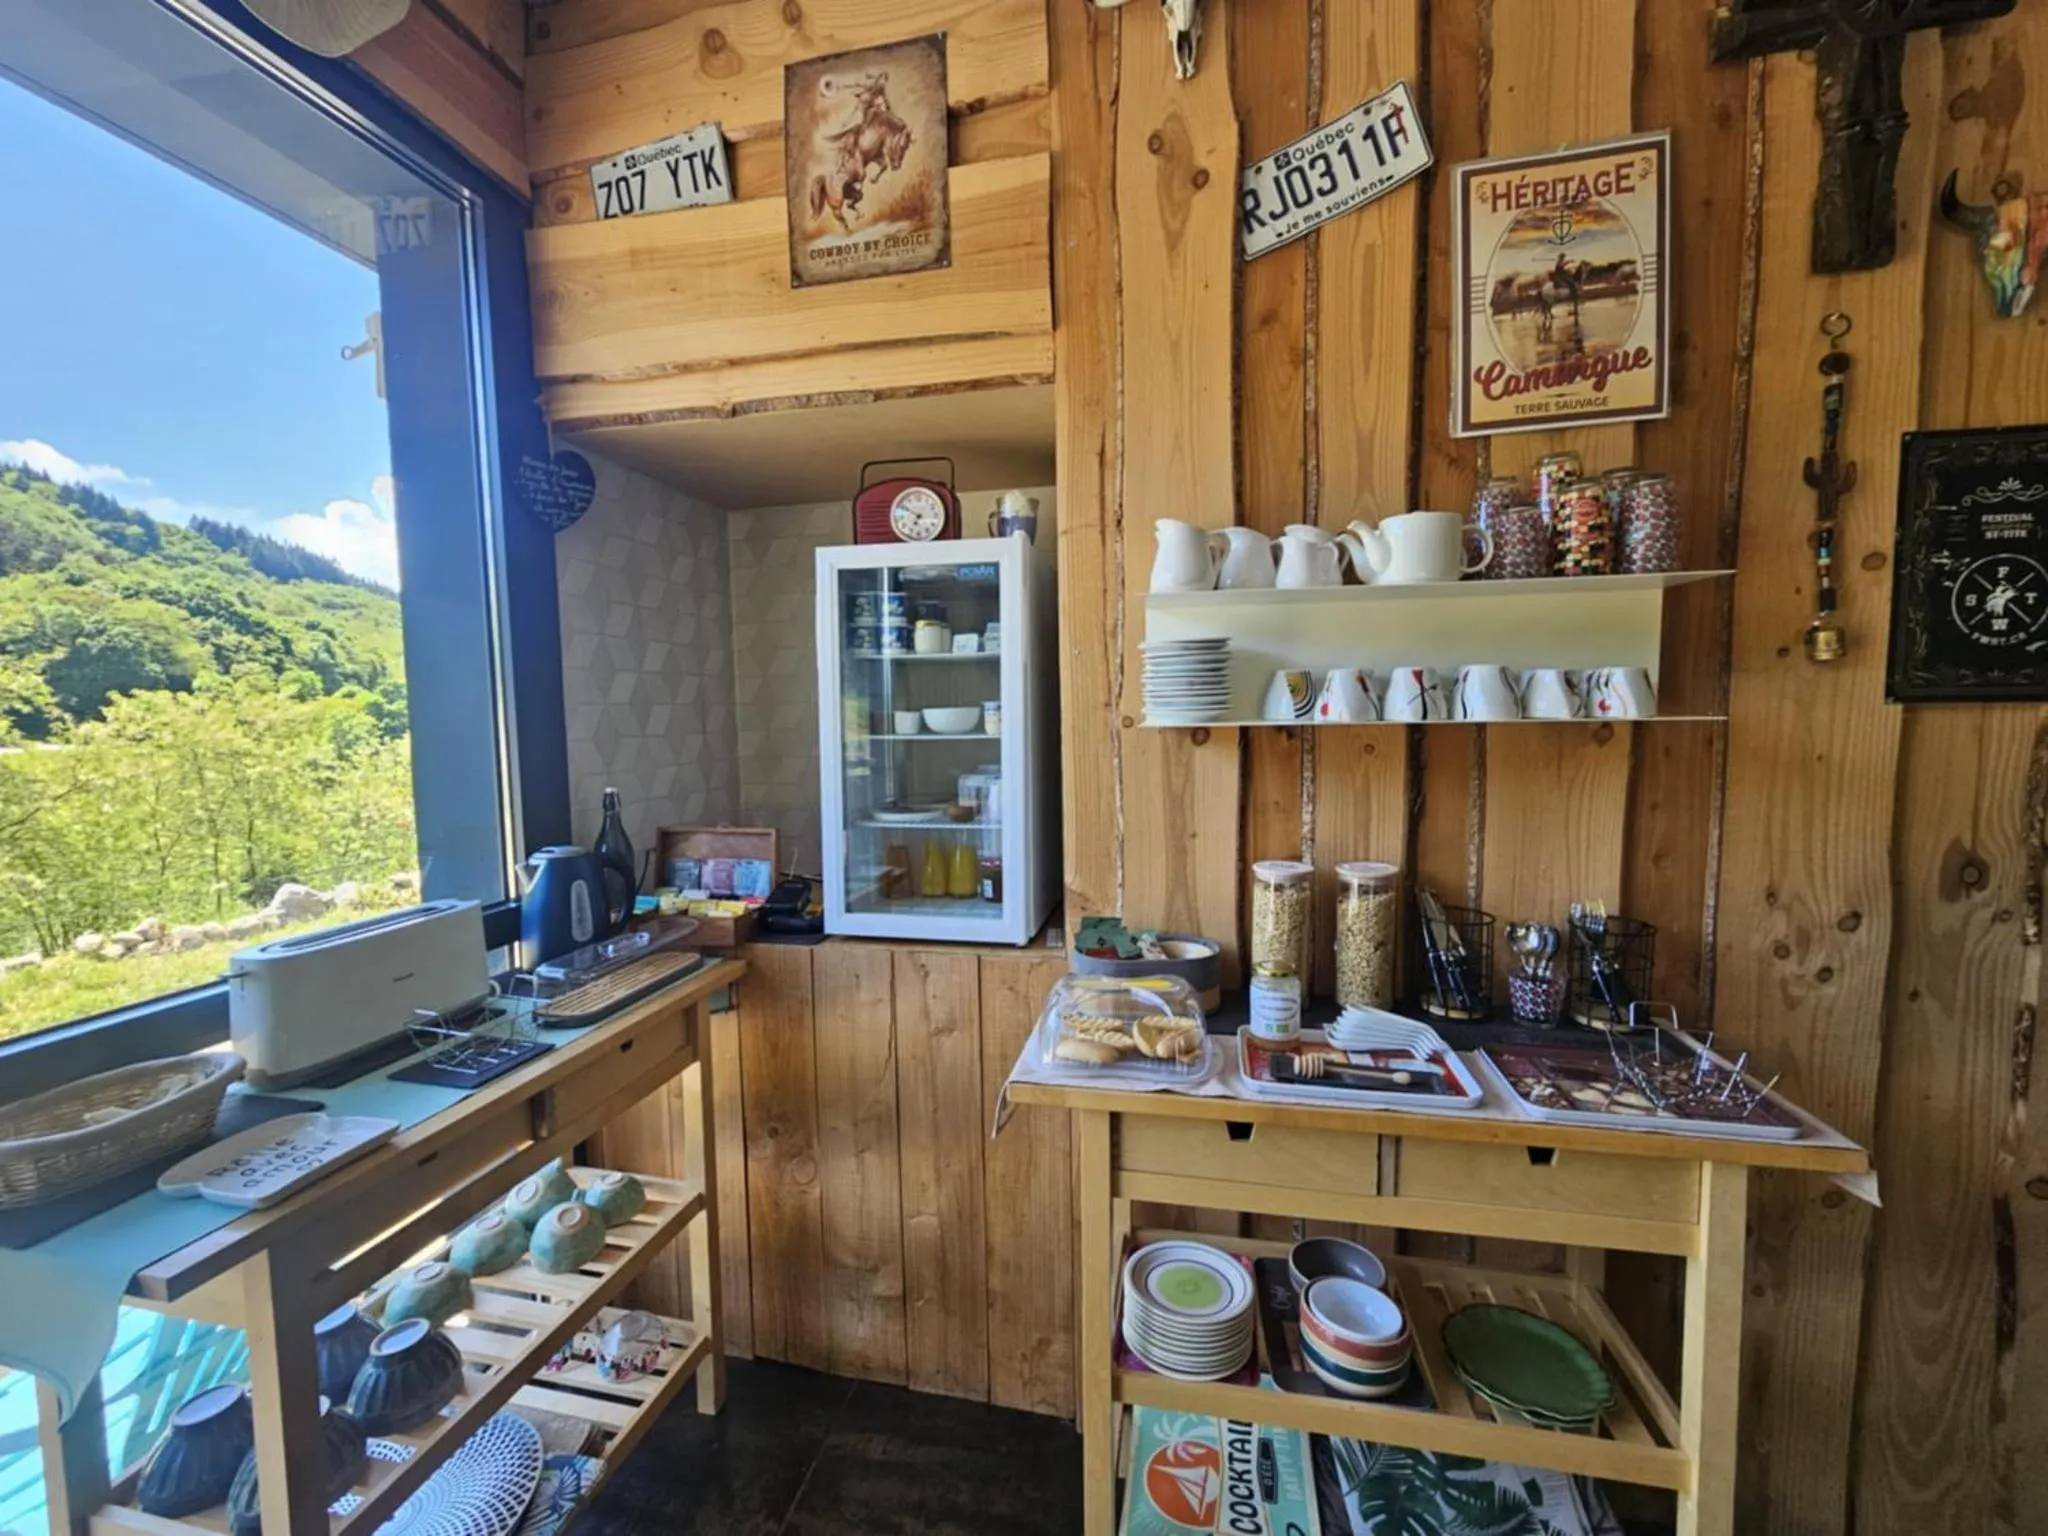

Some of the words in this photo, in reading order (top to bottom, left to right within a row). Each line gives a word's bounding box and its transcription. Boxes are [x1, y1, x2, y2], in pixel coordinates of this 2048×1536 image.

[1293, 121, 1355, 162] Québec
[666, 145, 722, 199] YTK
[1490, 161, 1636, 213] HÉRITAGE
[1303, 210, 1323, 224] me
[1326, 177, 1387, 214] souviens
[809, 241, 860, 260] COWBOY
[864, 240, 881, 252] BY
[884, 232, 932, 250] CHOICE
[1473, 345, 1653, 400] Camargue
[1514, 404, 1550, 415] TERRE
[1554, 396, 1610, 411] SAUVAGE
